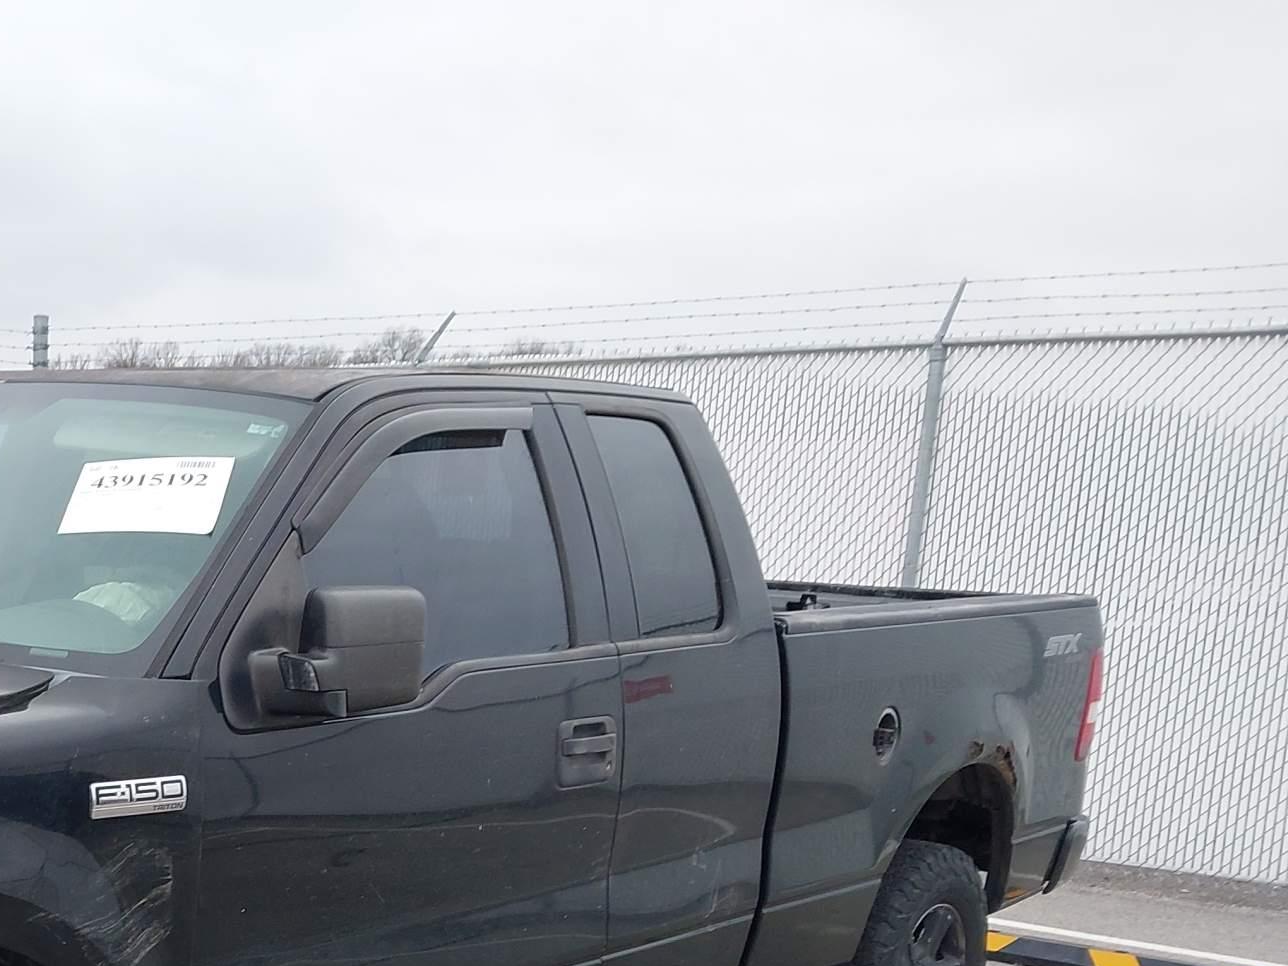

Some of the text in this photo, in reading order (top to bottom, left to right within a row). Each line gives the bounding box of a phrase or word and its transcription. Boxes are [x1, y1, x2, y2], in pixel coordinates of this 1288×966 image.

[90, 472, 209, 489] 43915192
[1043, 632, 1083, 657] STX
[95, 779, 184, 805] F-150
[152, 801, 185, 811] TRITON
